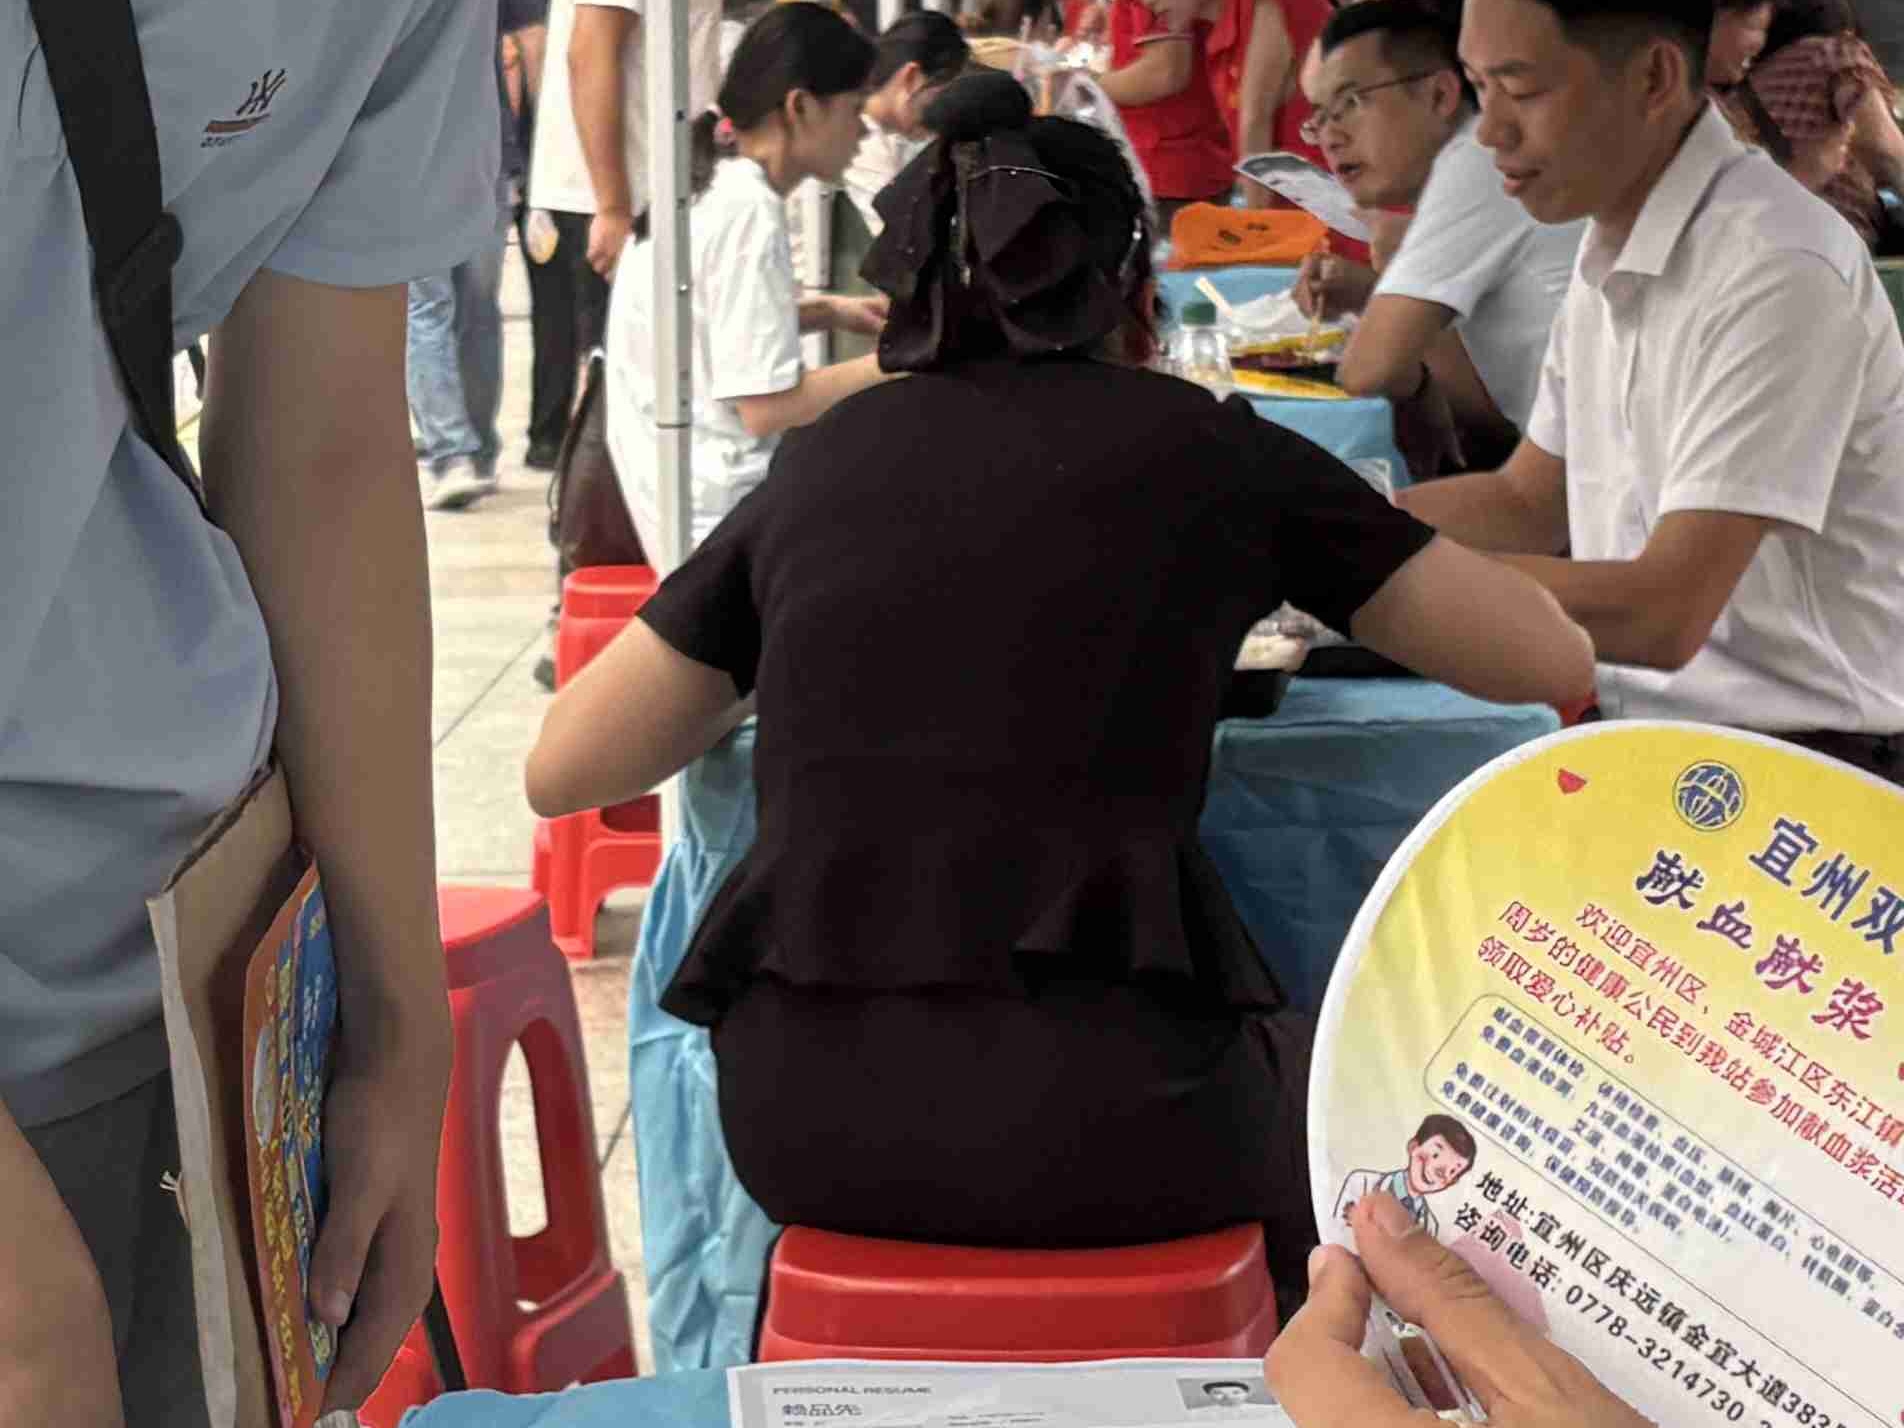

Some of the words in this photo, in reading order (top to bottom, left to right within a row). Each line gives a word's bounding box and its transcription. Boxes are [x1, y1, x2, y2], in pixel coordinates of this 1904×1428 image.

[1470, 930, 1652, 1073] 领取爱心补贴。
[1632, 845, 1894, 1049] 献血献浆
[1562, 1282, 1747, 1425] 0778-3214730
